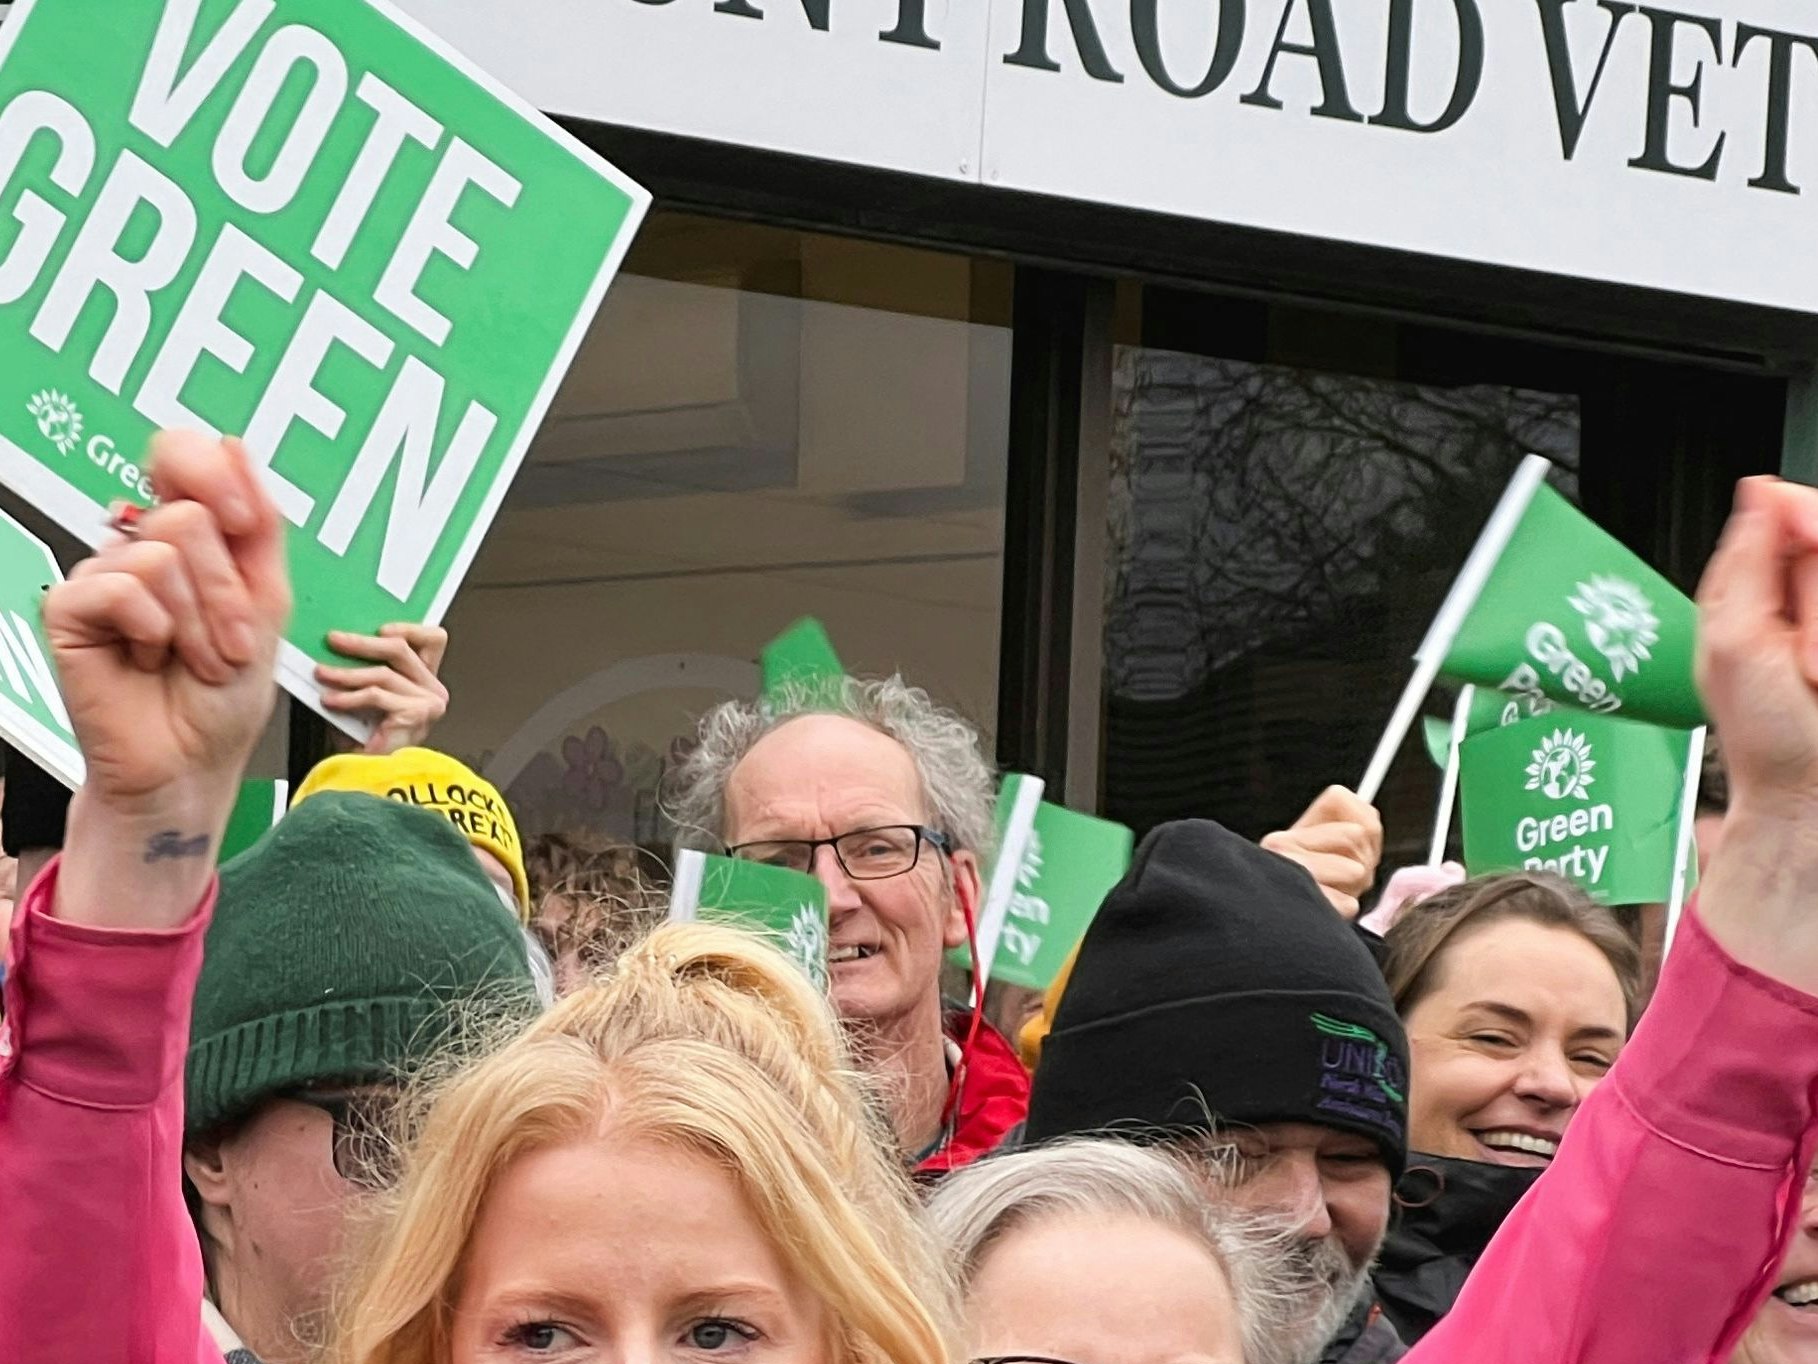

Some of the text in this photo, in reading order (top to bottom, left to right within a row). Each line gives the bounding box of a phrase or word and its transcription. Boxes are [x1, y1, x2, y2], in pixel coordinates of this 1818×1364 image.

[129, 0, 524, 348] VOTE
[0, 90, 499, 604] GREEN
[86, 434, 161, 506] Gree
[1516, 803, 1614, 852] Green
